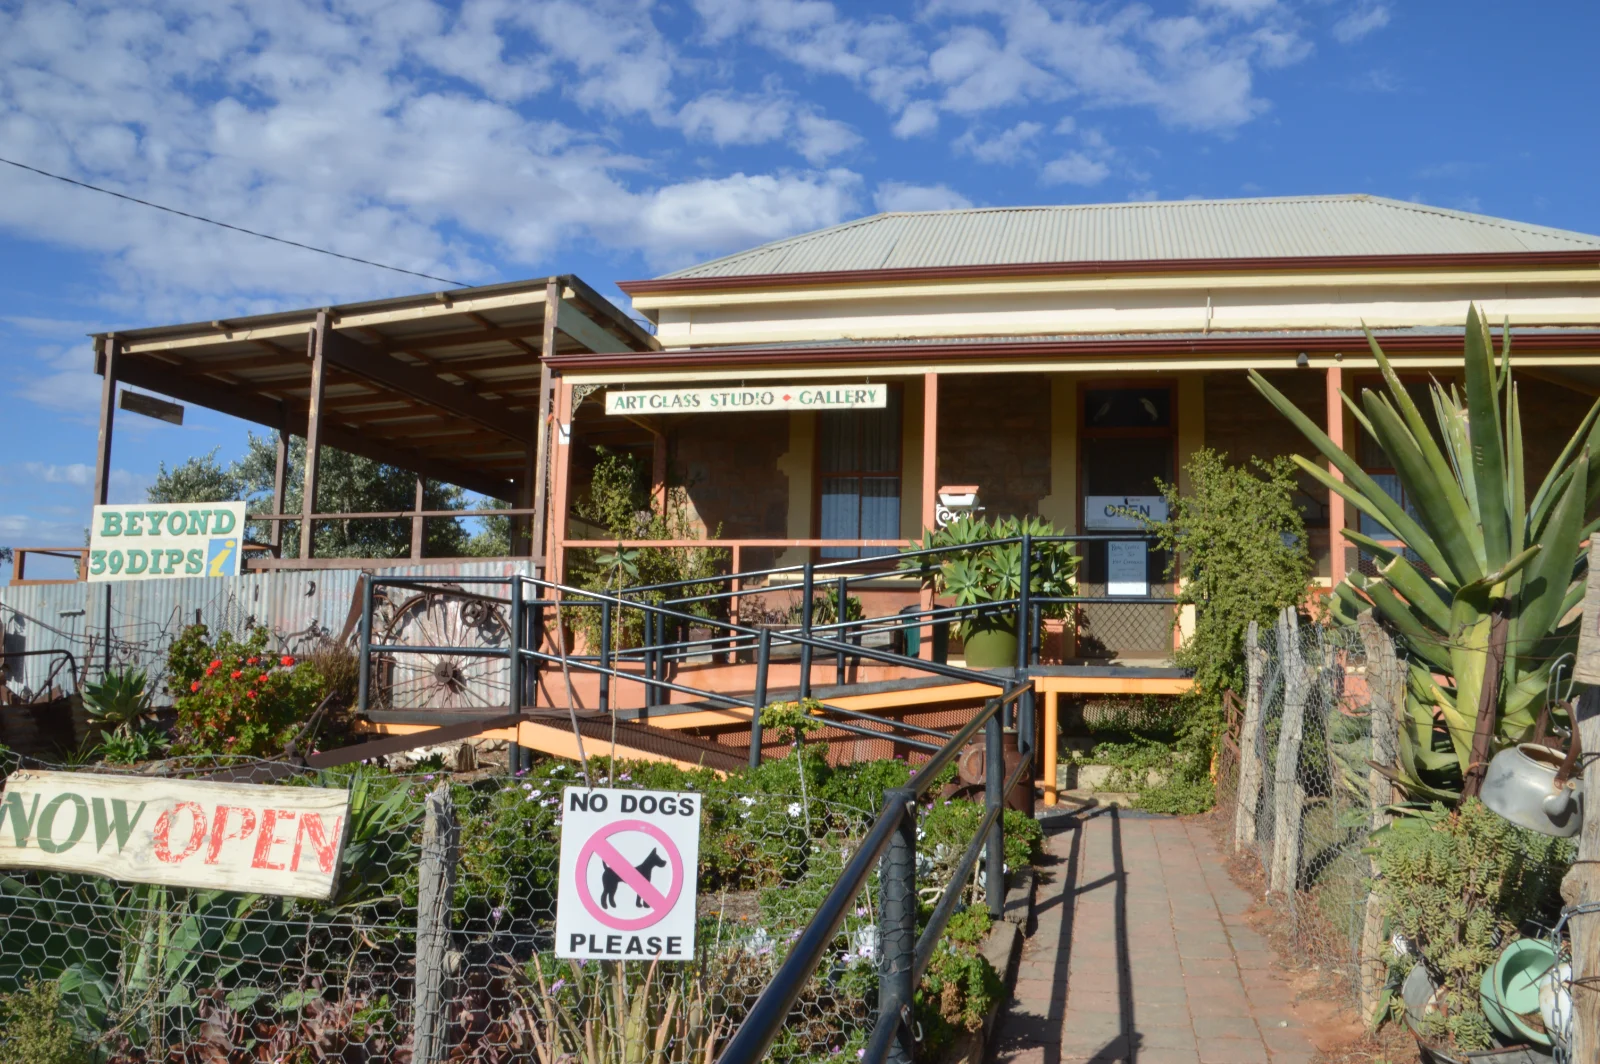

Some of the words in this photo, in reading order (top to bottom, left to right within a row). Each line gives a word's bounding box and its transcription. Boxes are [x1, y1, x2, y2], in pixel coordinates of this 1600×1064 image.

[710, 391, 774, 407] STUDIO
[799, 389, 877, 405] GALLERY
[100, 509, 236, 537] BEYOND
[570, 793, 608, 813] NO
[620, 794, 694, 817] DOGS
[0, 791, 147, 854] NOW
[153, 801, 342, 875] OPEN
[569, 933, 682, 956] PLEASE
